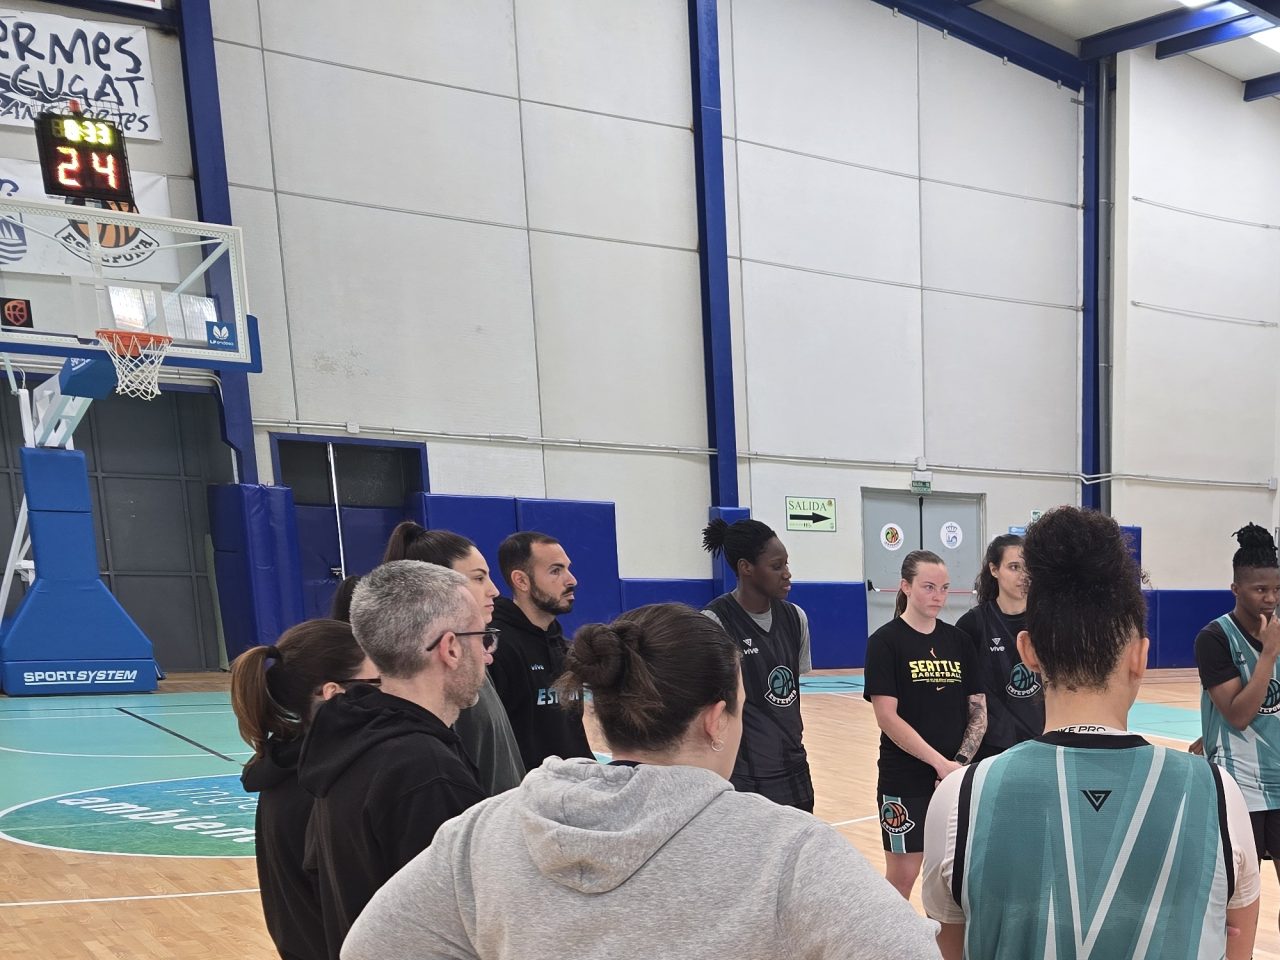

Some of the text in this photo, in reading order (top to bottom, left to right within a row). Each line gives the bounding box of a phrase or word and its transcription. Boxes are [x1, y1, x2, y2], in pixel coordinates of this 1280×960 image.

[57, 147, 118, 190] 24
[788, 500, 827, 511] SALIDA
[909, 660, 962, 673] SEATTLE
[24, 669, 138, 683] SPORTSYSTEM
